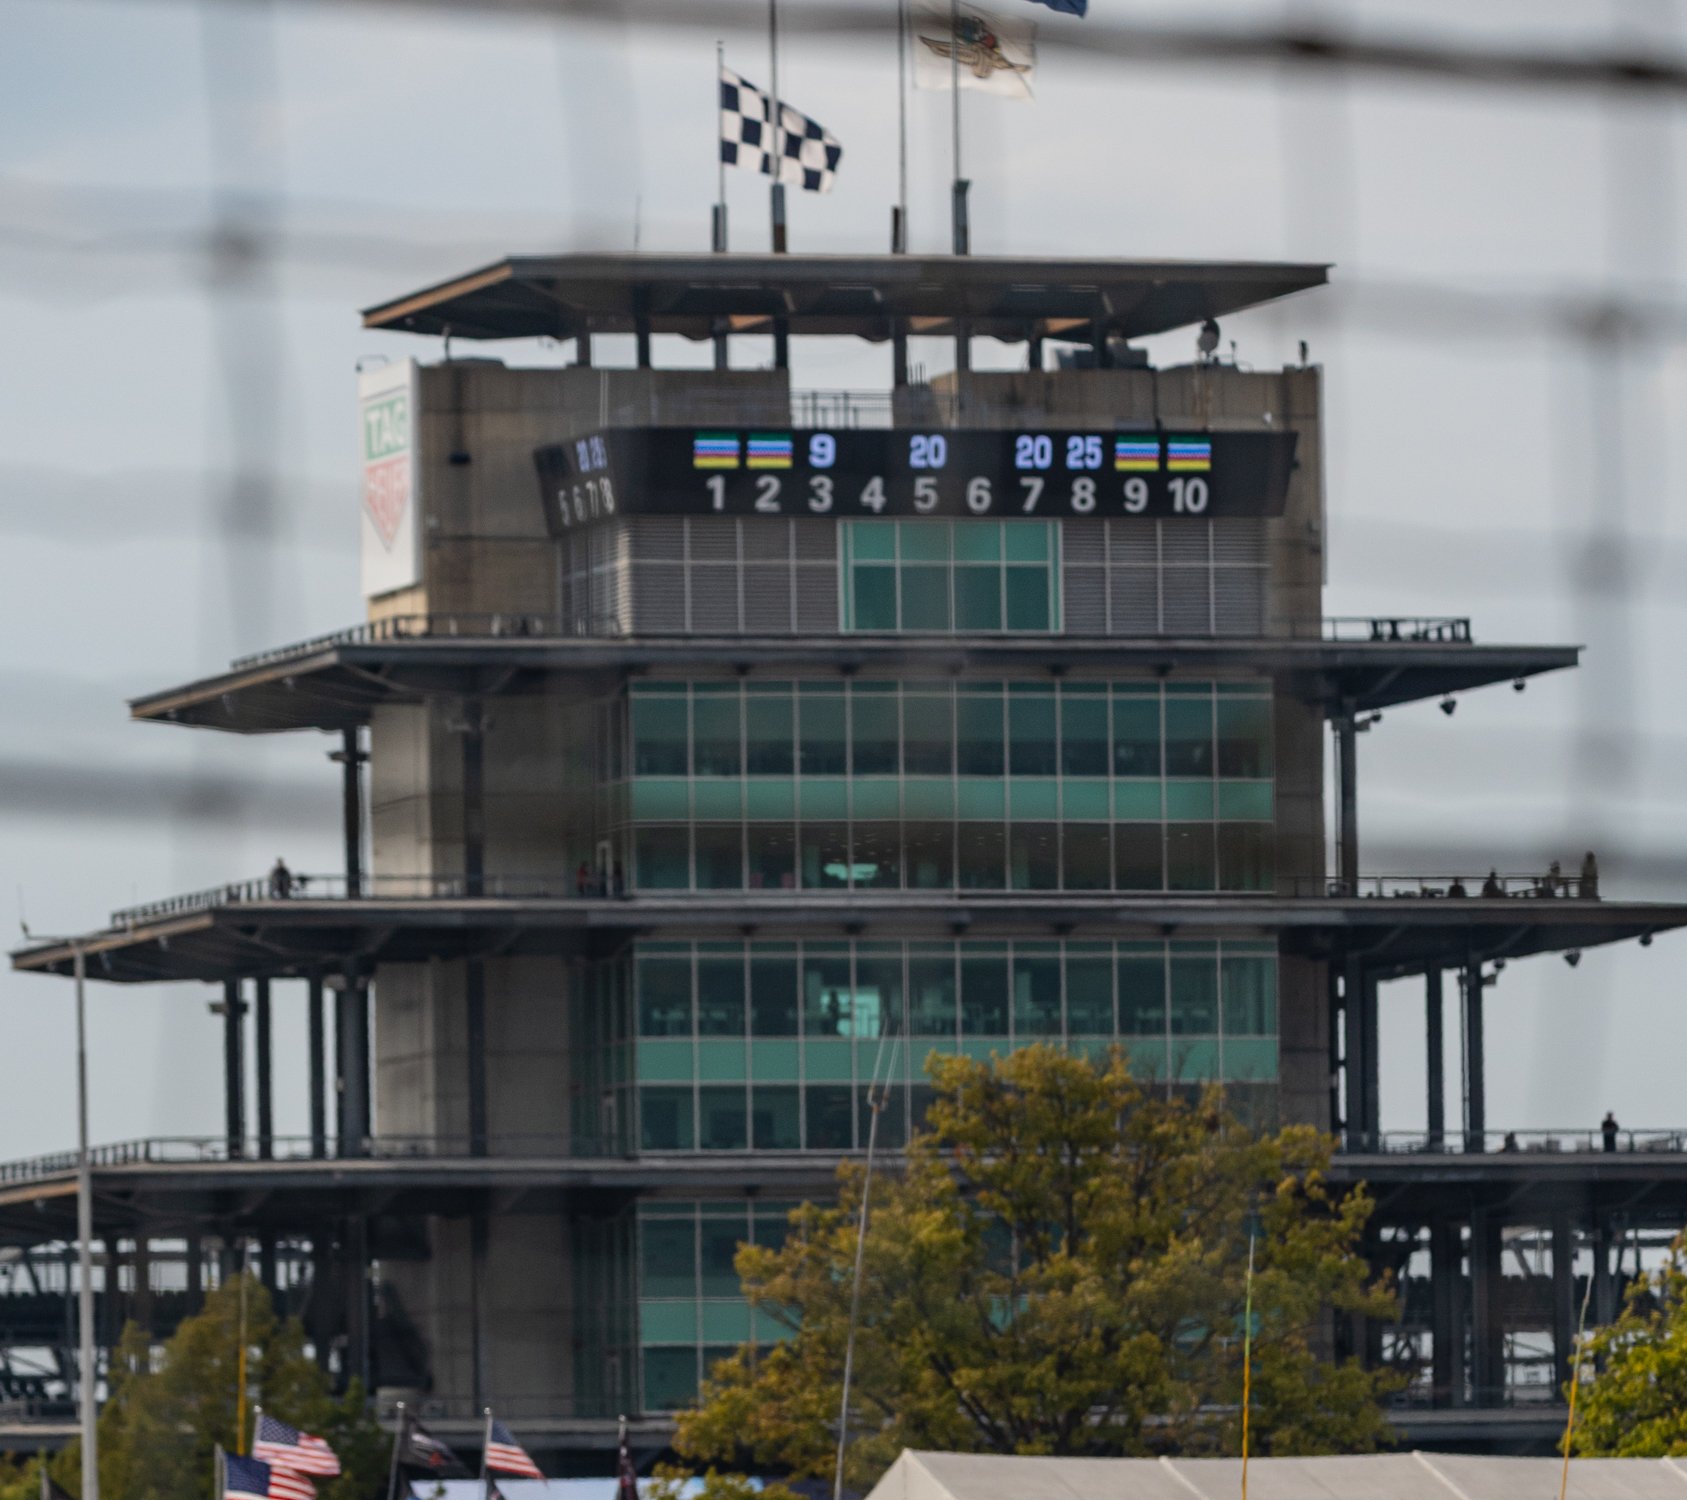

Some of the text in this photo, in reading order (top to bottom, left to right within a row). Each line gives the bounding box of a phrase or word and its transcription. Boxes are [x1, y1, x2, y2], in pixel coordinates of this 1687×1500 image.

[367, 402, 408, 453] TAG
[809, 433, 1103, 469] 9 20 20 25
[707, 475, 1208, 513] 1 2 3 4 5 6 7 8 9 10
